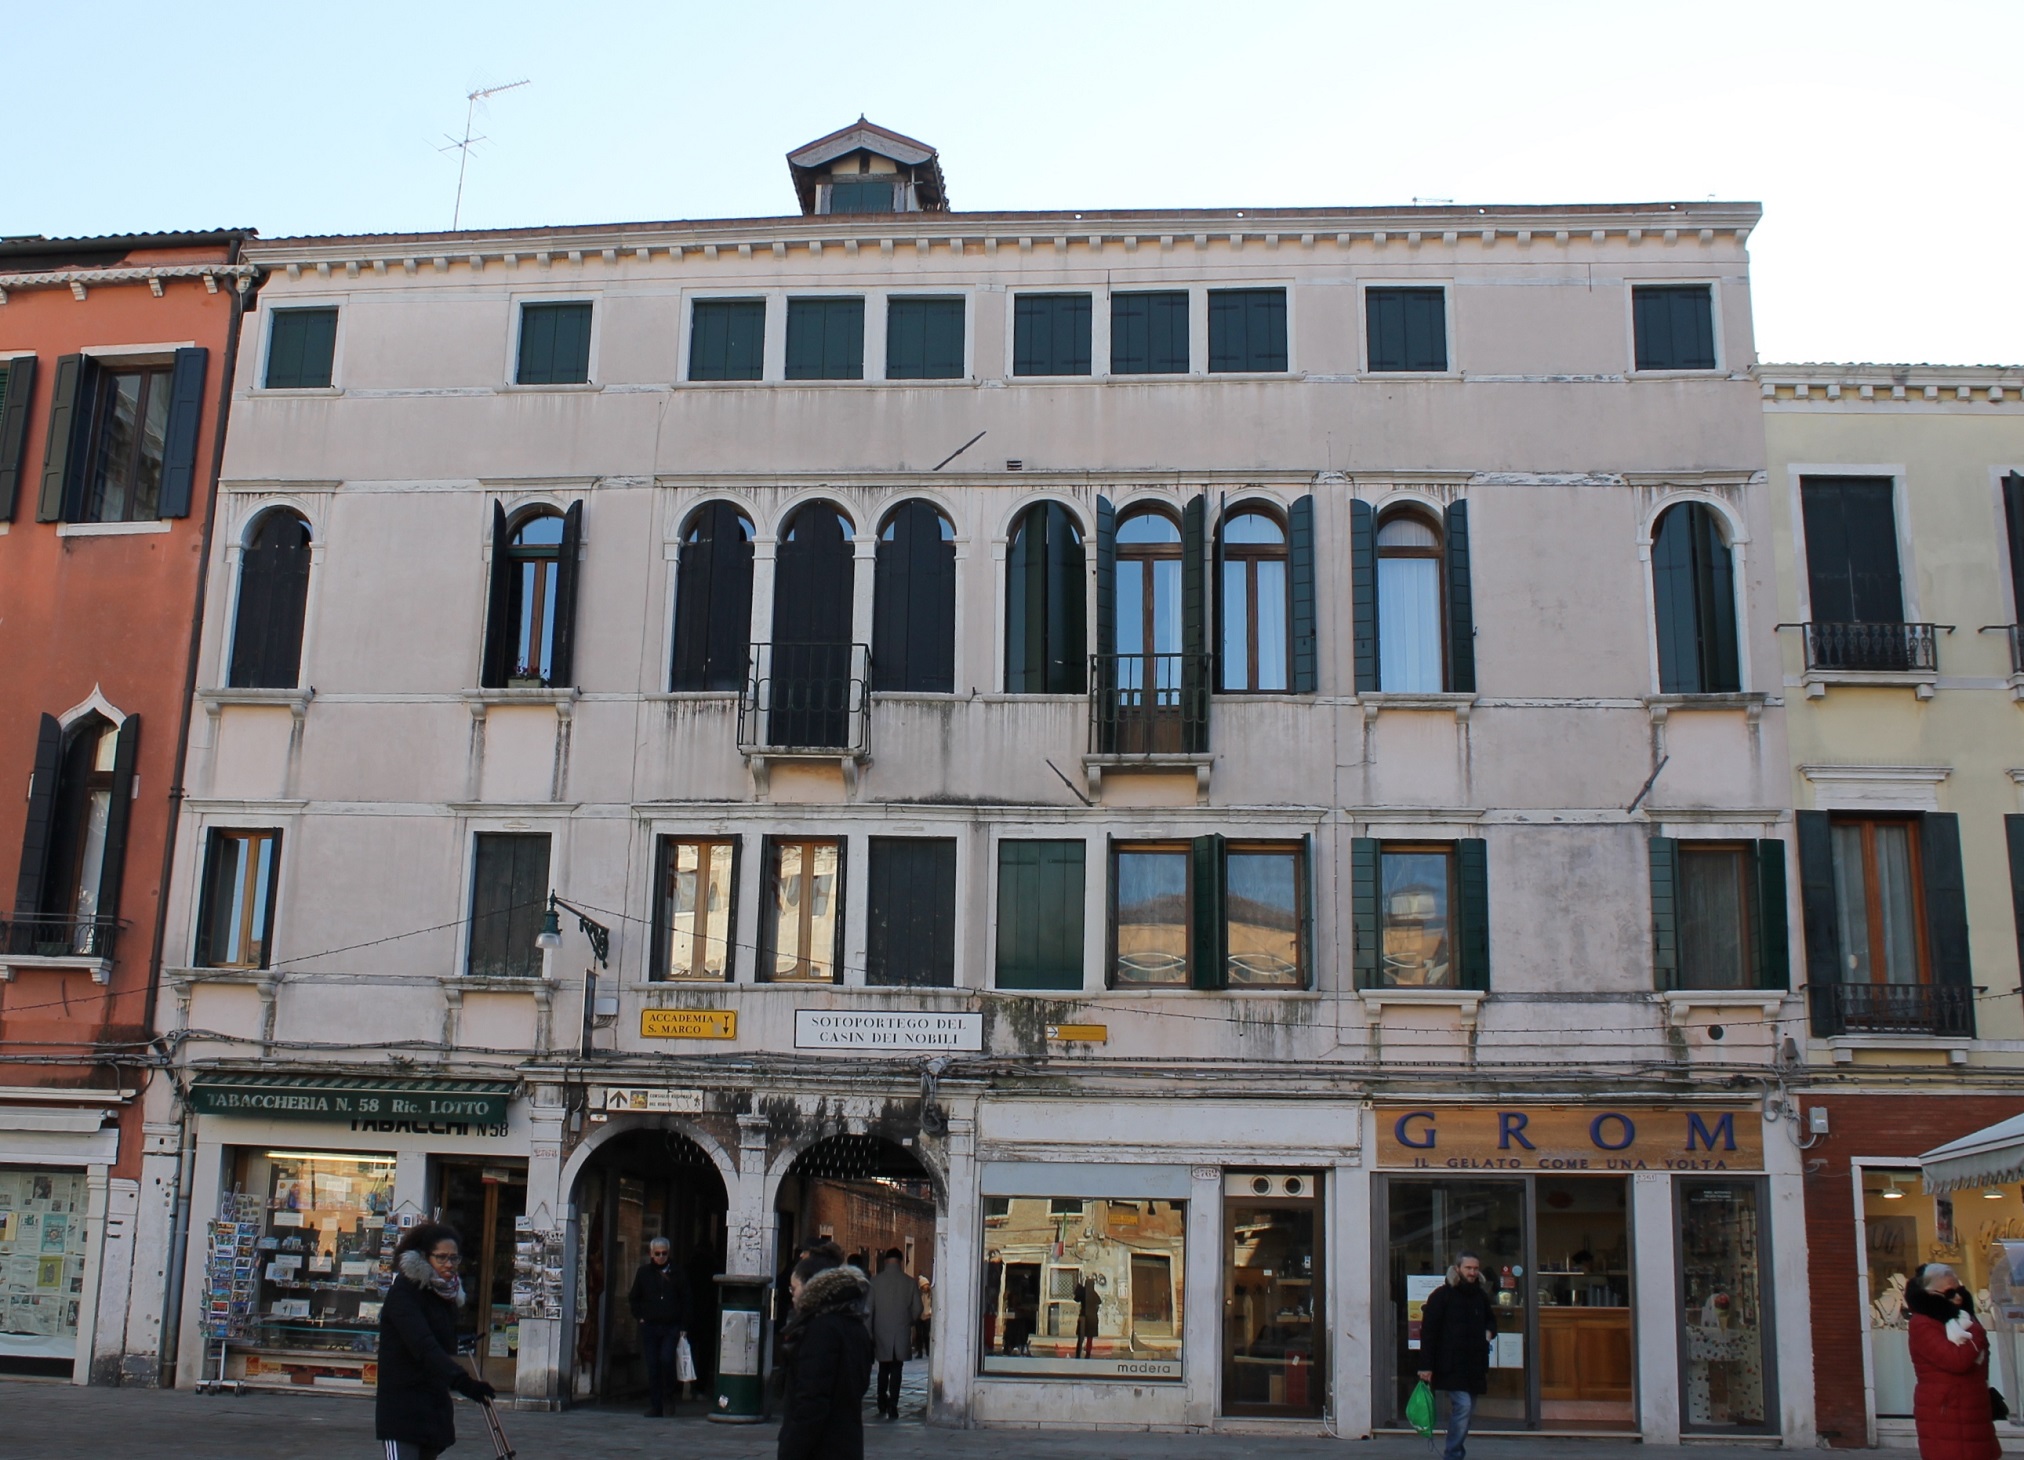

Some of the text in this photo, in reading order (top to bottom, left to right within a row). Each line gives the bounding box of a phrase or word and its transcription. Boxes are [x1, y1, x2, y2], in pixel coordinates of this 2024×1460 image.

[649, 1013, 714, 1023] ACCADEMIA
[811, 1016, 967, 1030] SOTOPORTEGO DEL
[648, 1024, 701, 1034] S. MARCO
[819, 1031, 958, 1045] CASIN DEI NOBILI
[207, 1093, 490, 1116] TABACCHERIA N. 58 Ric. LOTTO
[1394, 1110, 1738, 1151] GROM
[1414, 1158, 1728, 1170] IL GELATO COME UNA VOLTA
[1117, 1362, 1171, 1374] madera
